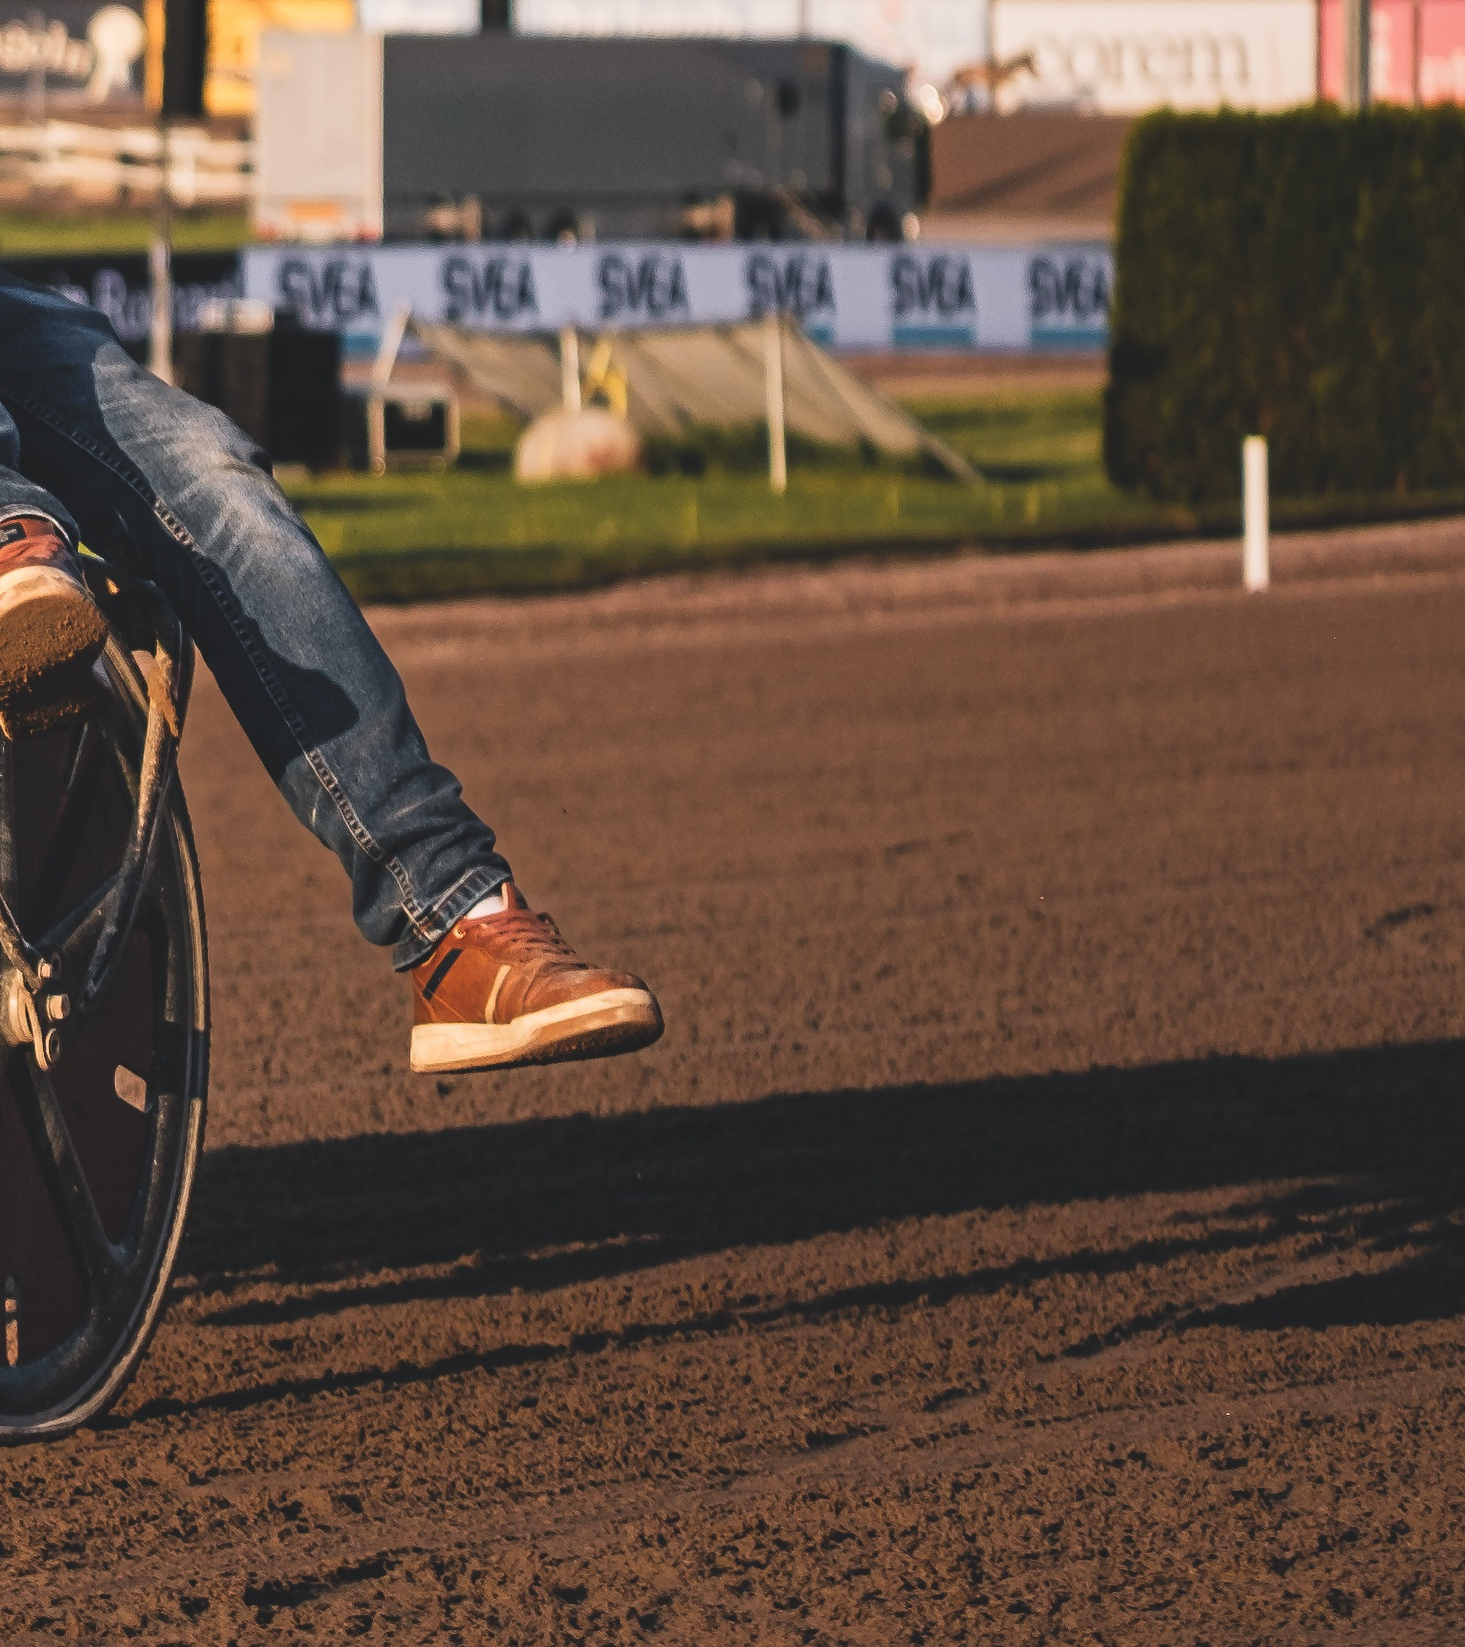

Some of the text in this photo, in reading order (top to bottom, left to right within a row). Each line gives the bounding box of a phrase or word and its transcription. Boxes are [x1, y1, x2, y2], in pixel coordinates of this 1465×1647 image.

[278, 257, 379, 320] SVEA
[440, 256, 541, 320] SVEA
[598, 253, 691, 317] SVEA
[744, 253, 837, 317] SVEA
[890, 252, 976, 315] SVEA
